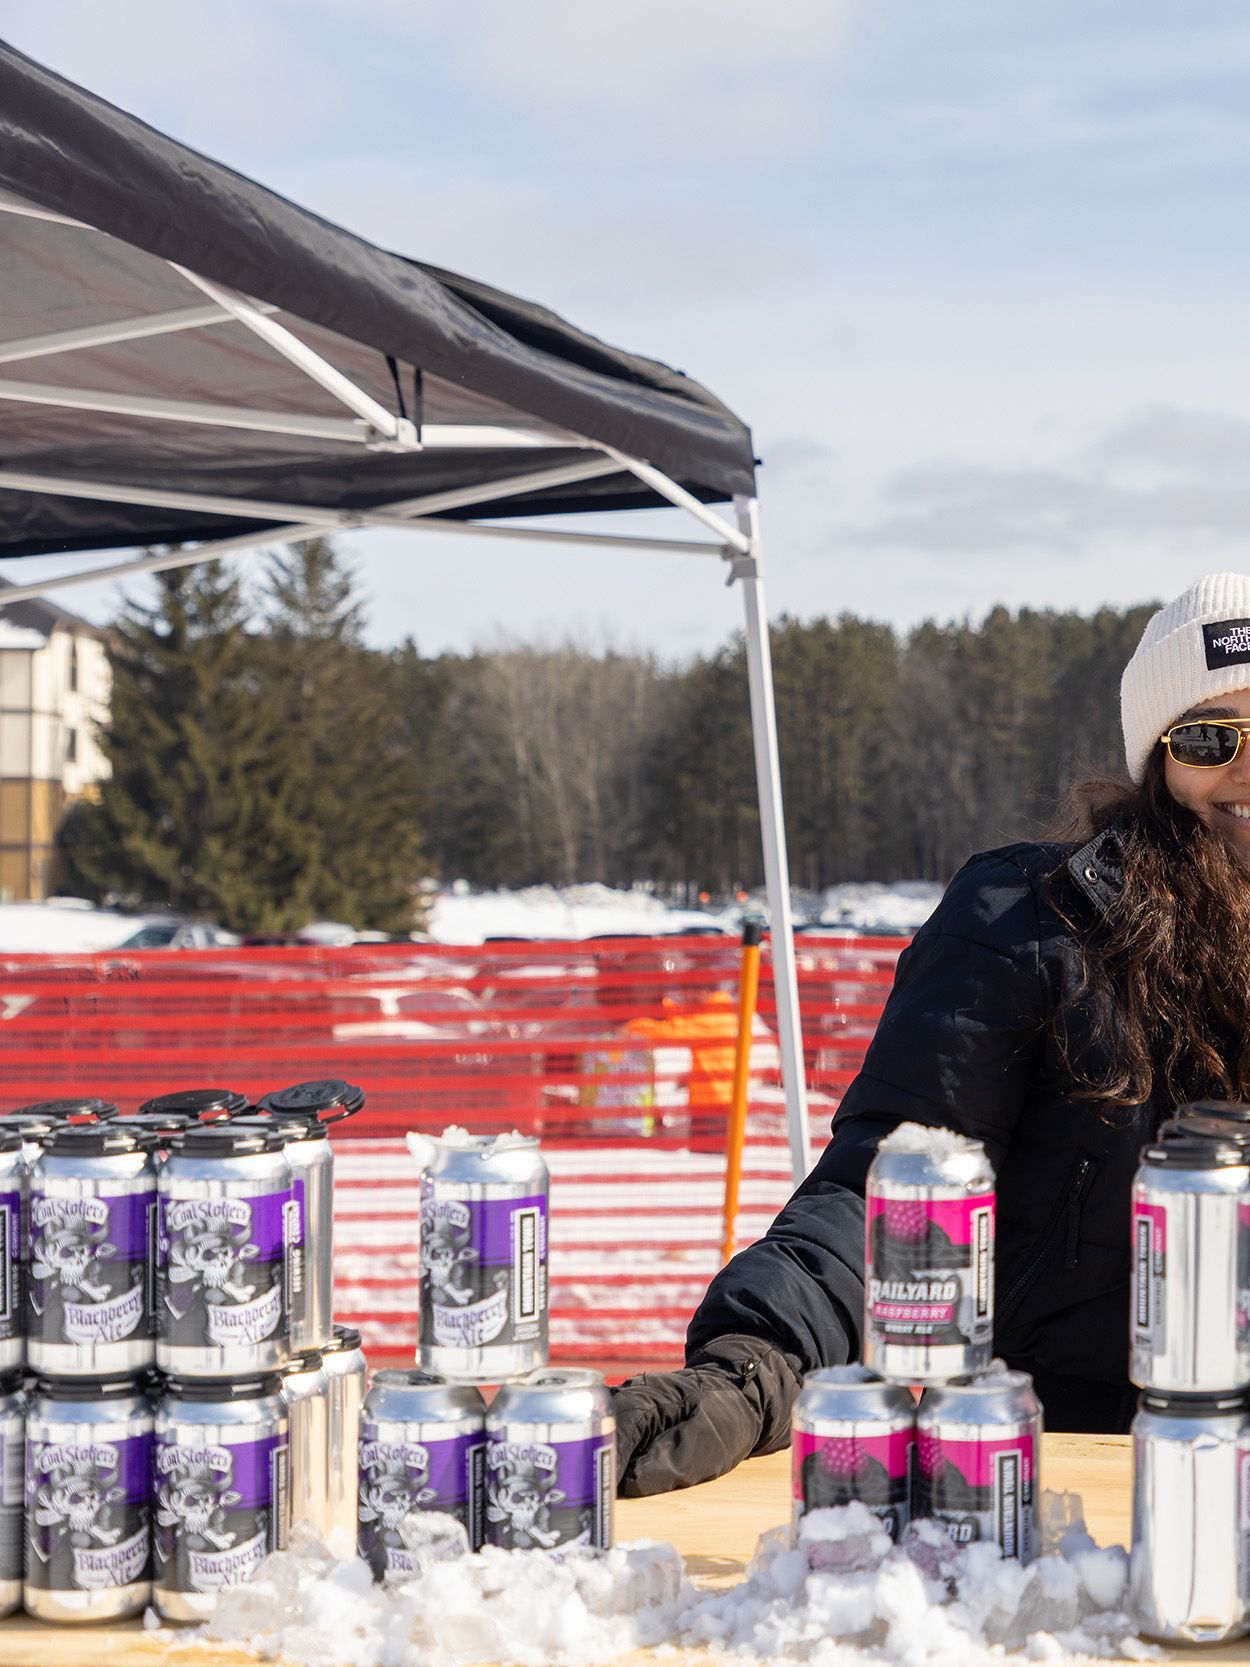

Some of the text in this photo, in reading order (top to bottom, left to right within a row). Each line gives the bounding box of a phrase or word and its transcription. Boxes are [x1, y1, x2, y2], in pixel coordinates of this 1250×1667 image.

[868, 1280, 956, 1309] RAILYARD
[876, 1305, 948, 1320] RASPBERRY
[1003, 1458, 1015, 1495] TOWN
